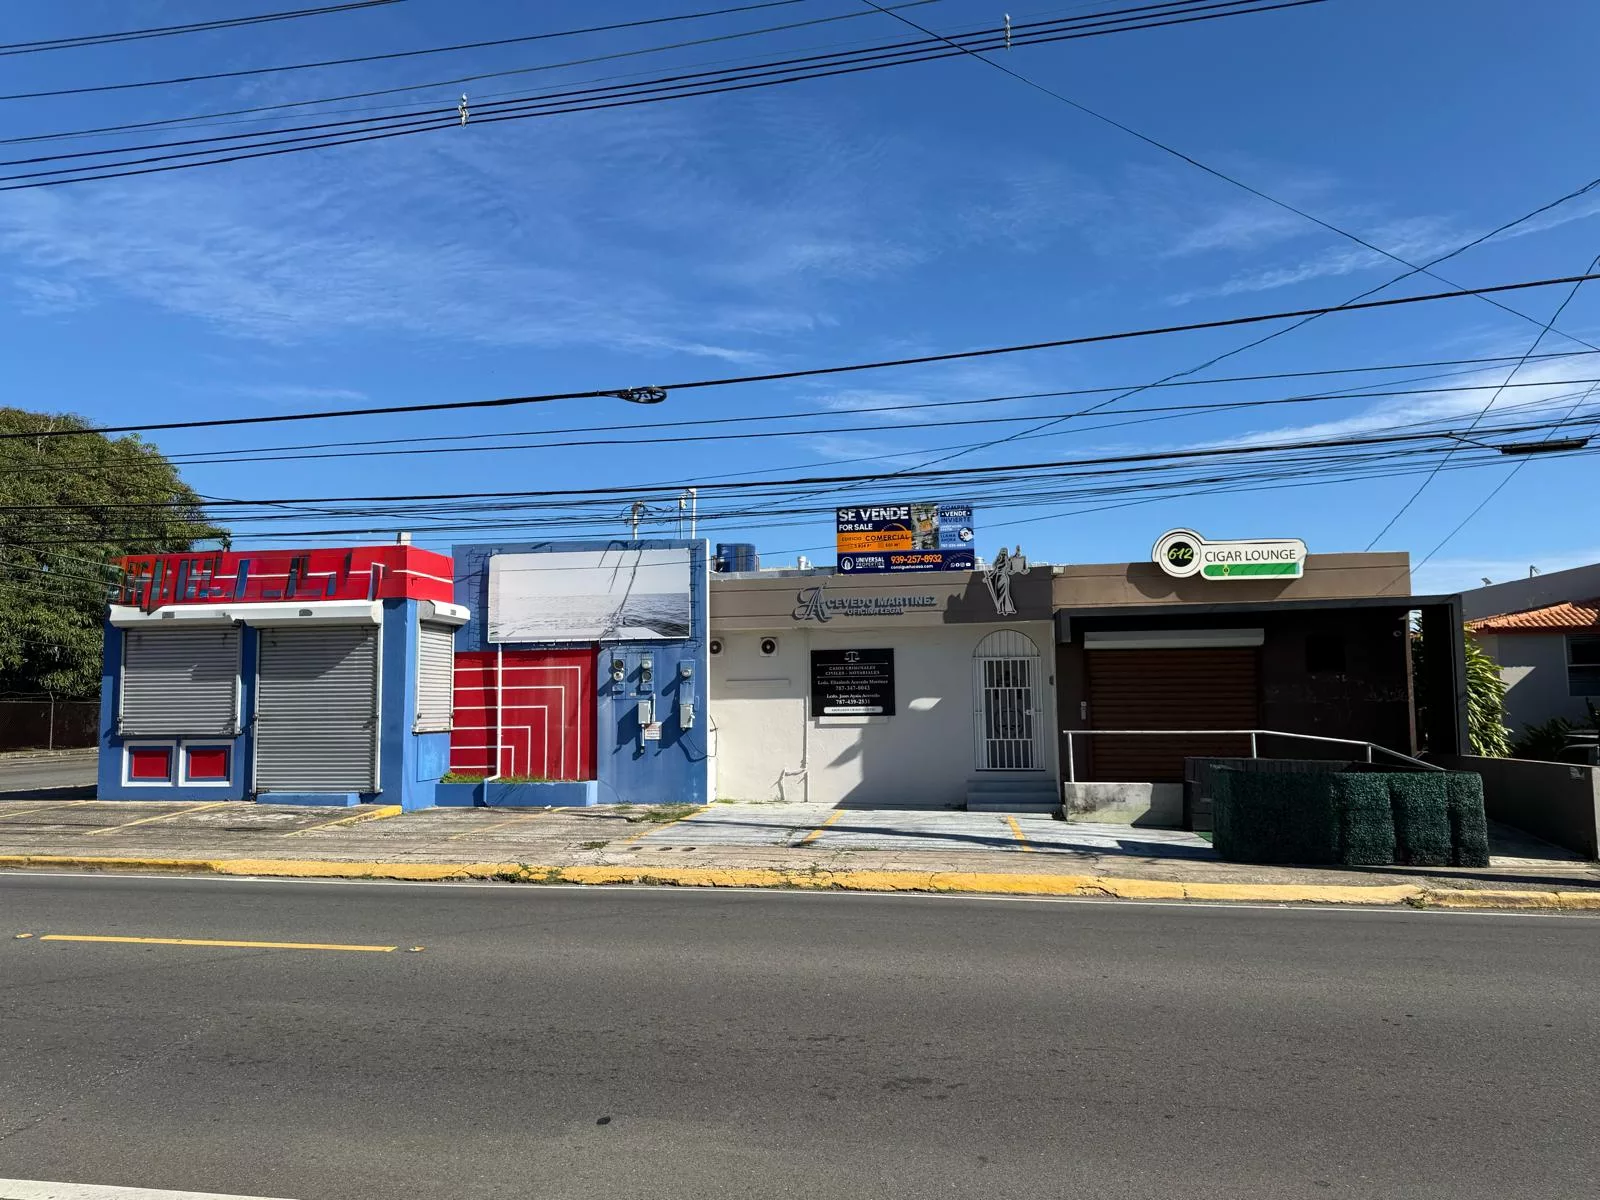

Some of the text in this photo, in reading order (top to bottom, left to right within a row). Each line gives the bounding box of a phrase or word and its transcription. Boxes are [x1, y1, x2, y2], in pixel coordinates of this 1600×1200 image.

[838, 506, 909, 521] SE VENDE
[890, 554, 942, 564] 939-257-8932
[1167, 547, 1193, 560] 612
[1204, 549, 1296, 562] CIGAR LOUNGE
[880, 606, 904, 614] LEGAL
